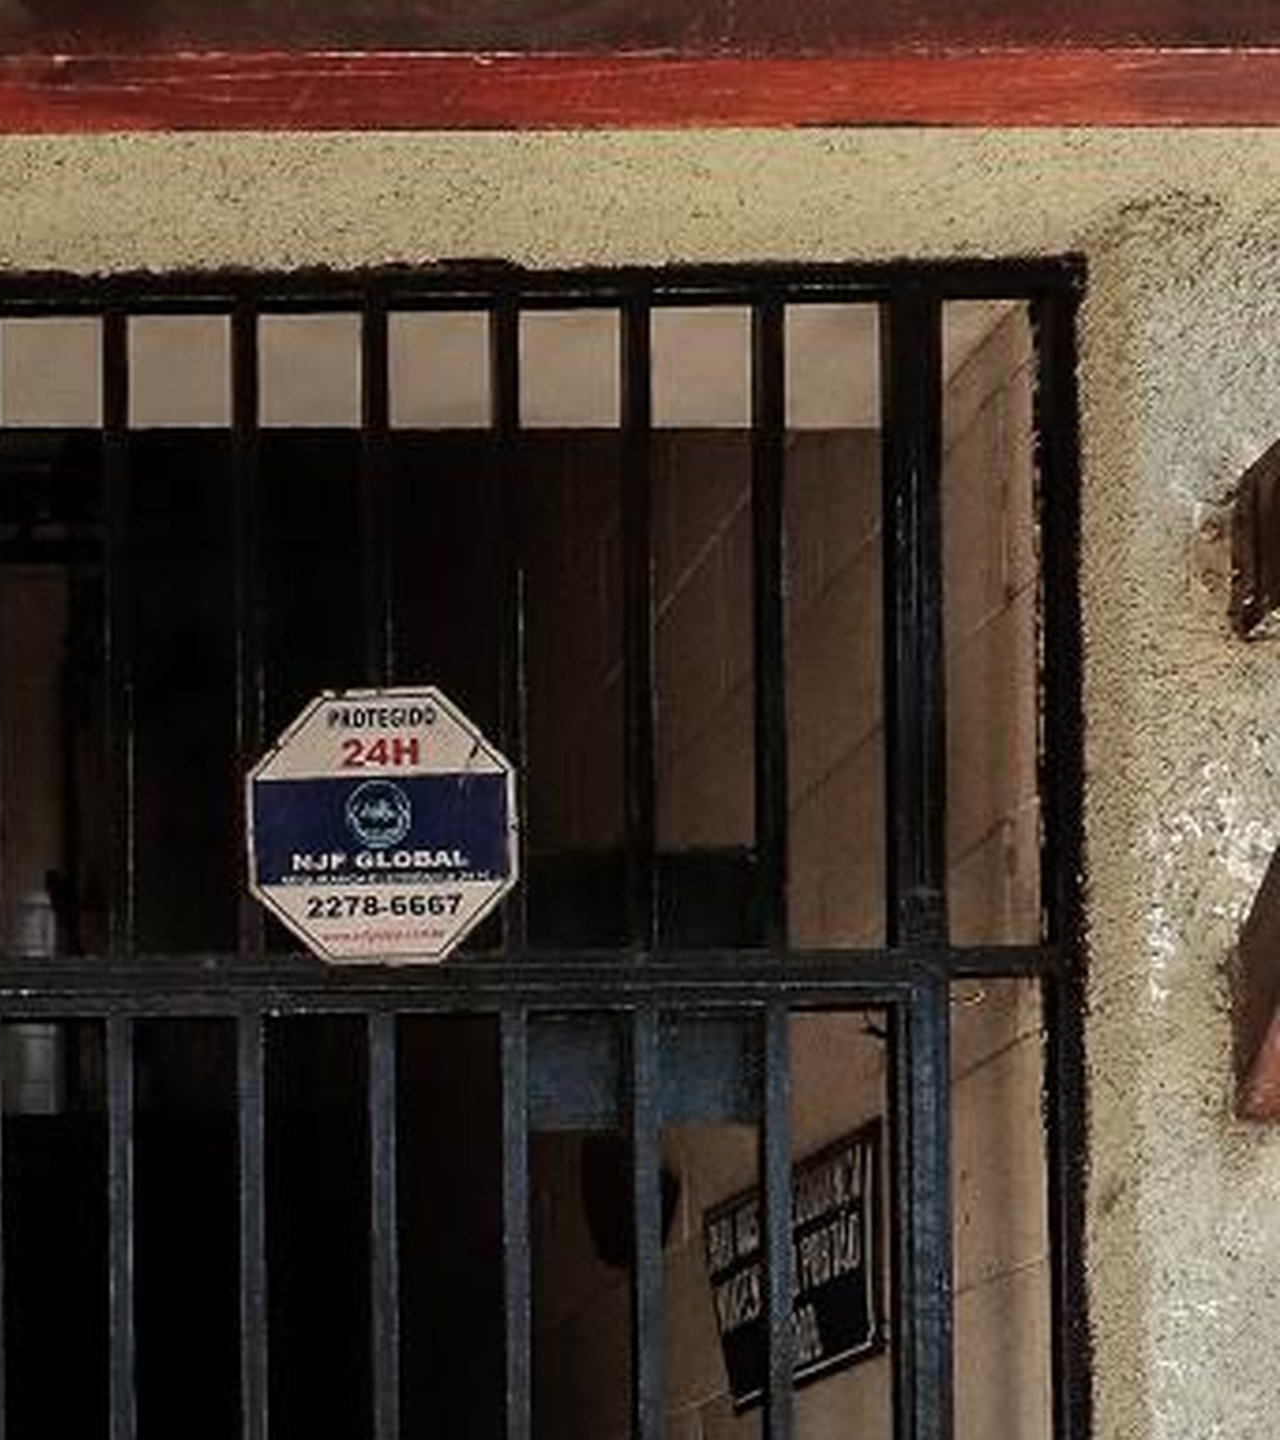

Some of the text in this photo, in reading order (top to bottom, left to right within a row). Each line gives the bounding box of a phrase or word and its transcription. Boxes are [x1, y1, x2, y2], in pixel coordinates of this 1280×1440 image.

[327, 705, 437, 729] PROTEGIDO
[341, 737, 420, 768] 24H
[355, 849, 470, 869] GLOBAL
[306, 894, 465, 920] 2278-6667
